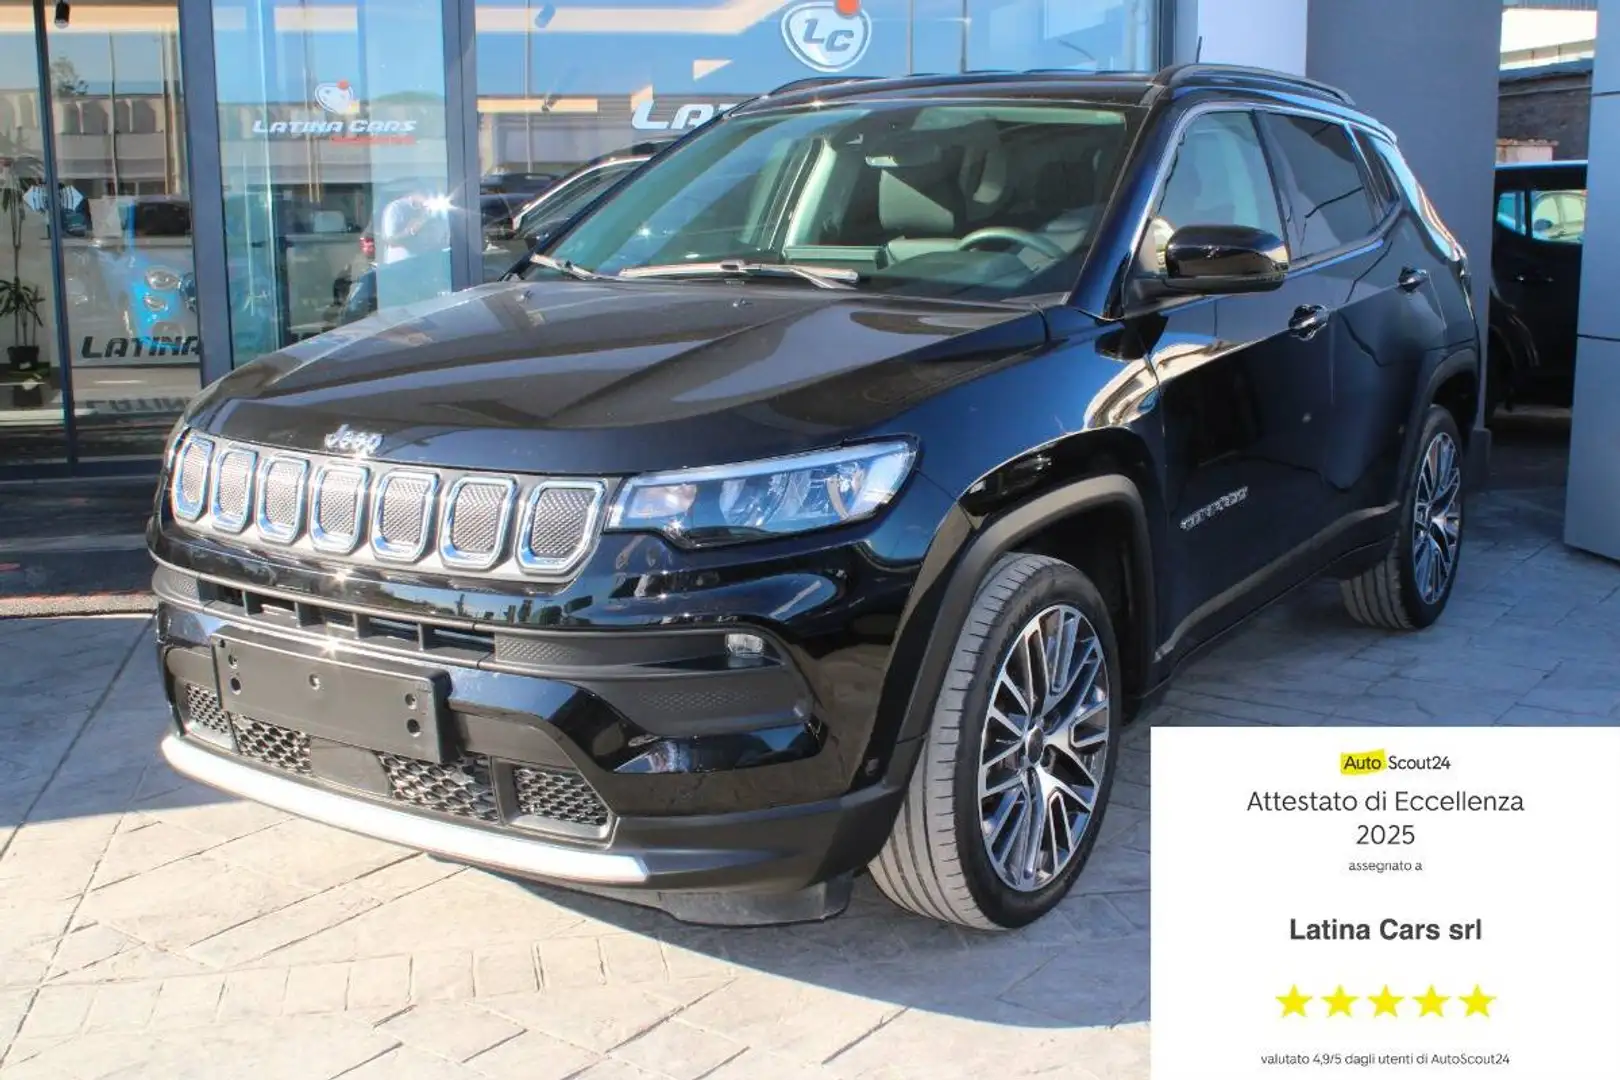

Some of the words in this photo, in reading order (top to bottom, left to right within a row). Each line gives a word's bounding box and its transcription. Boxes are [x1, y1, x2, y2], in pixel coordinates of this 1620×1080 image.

[803, 19, 855, 52] LC
[251, 119, 345, 134] LATINA
[349, 119, 417, 134] CARS
[631, 100, 738, 130] LA
